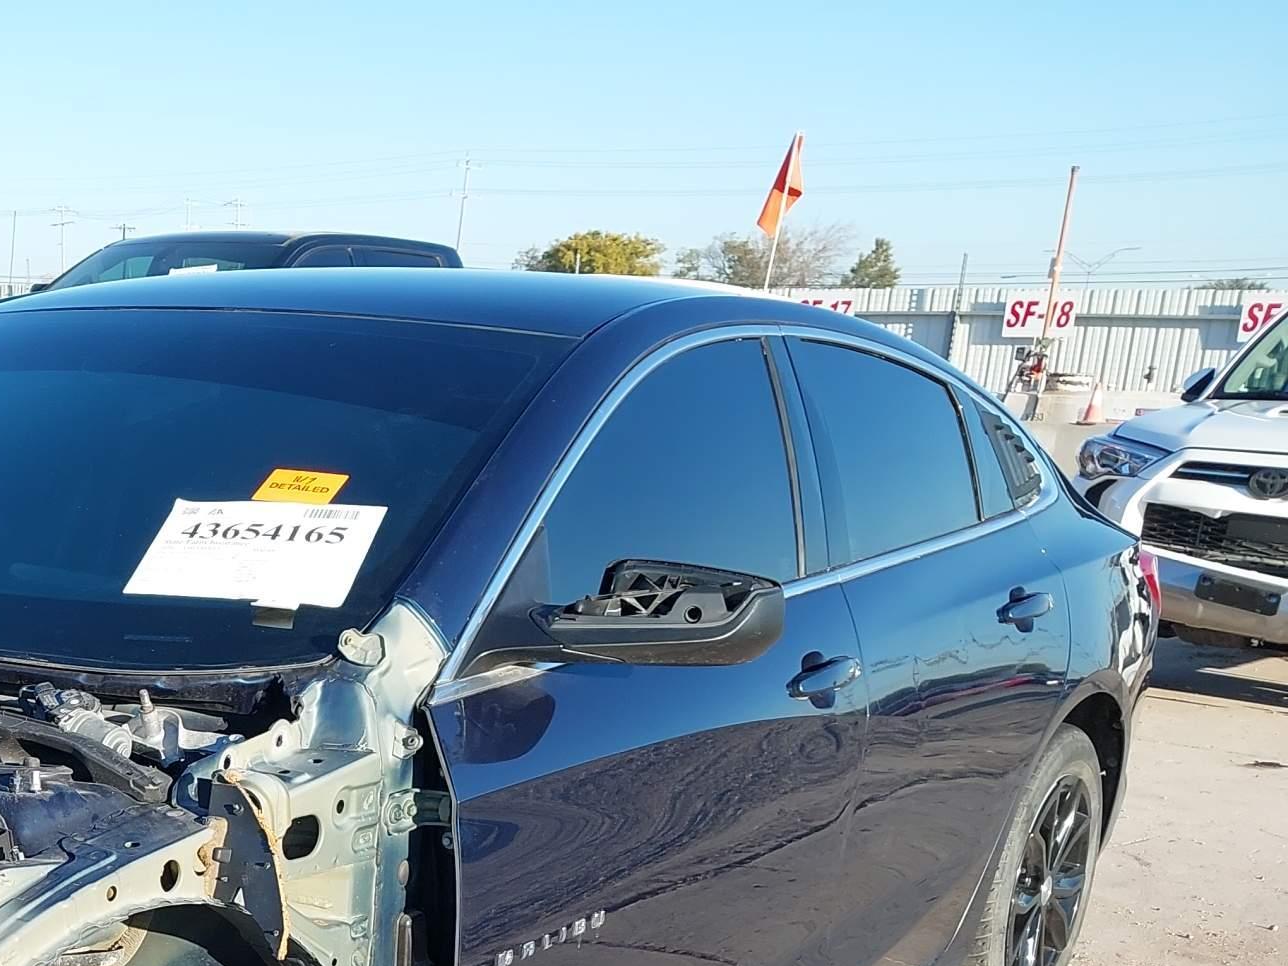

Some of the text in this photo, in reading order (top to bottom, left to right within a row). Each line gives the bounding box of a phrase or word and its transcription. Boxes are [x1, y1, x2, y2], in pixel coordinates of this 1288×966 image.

[1006, 300, 1074, 328] SF-18
[268, 482, 330, 494] DETAILED
[181, 522, 349, 545] 43654165
